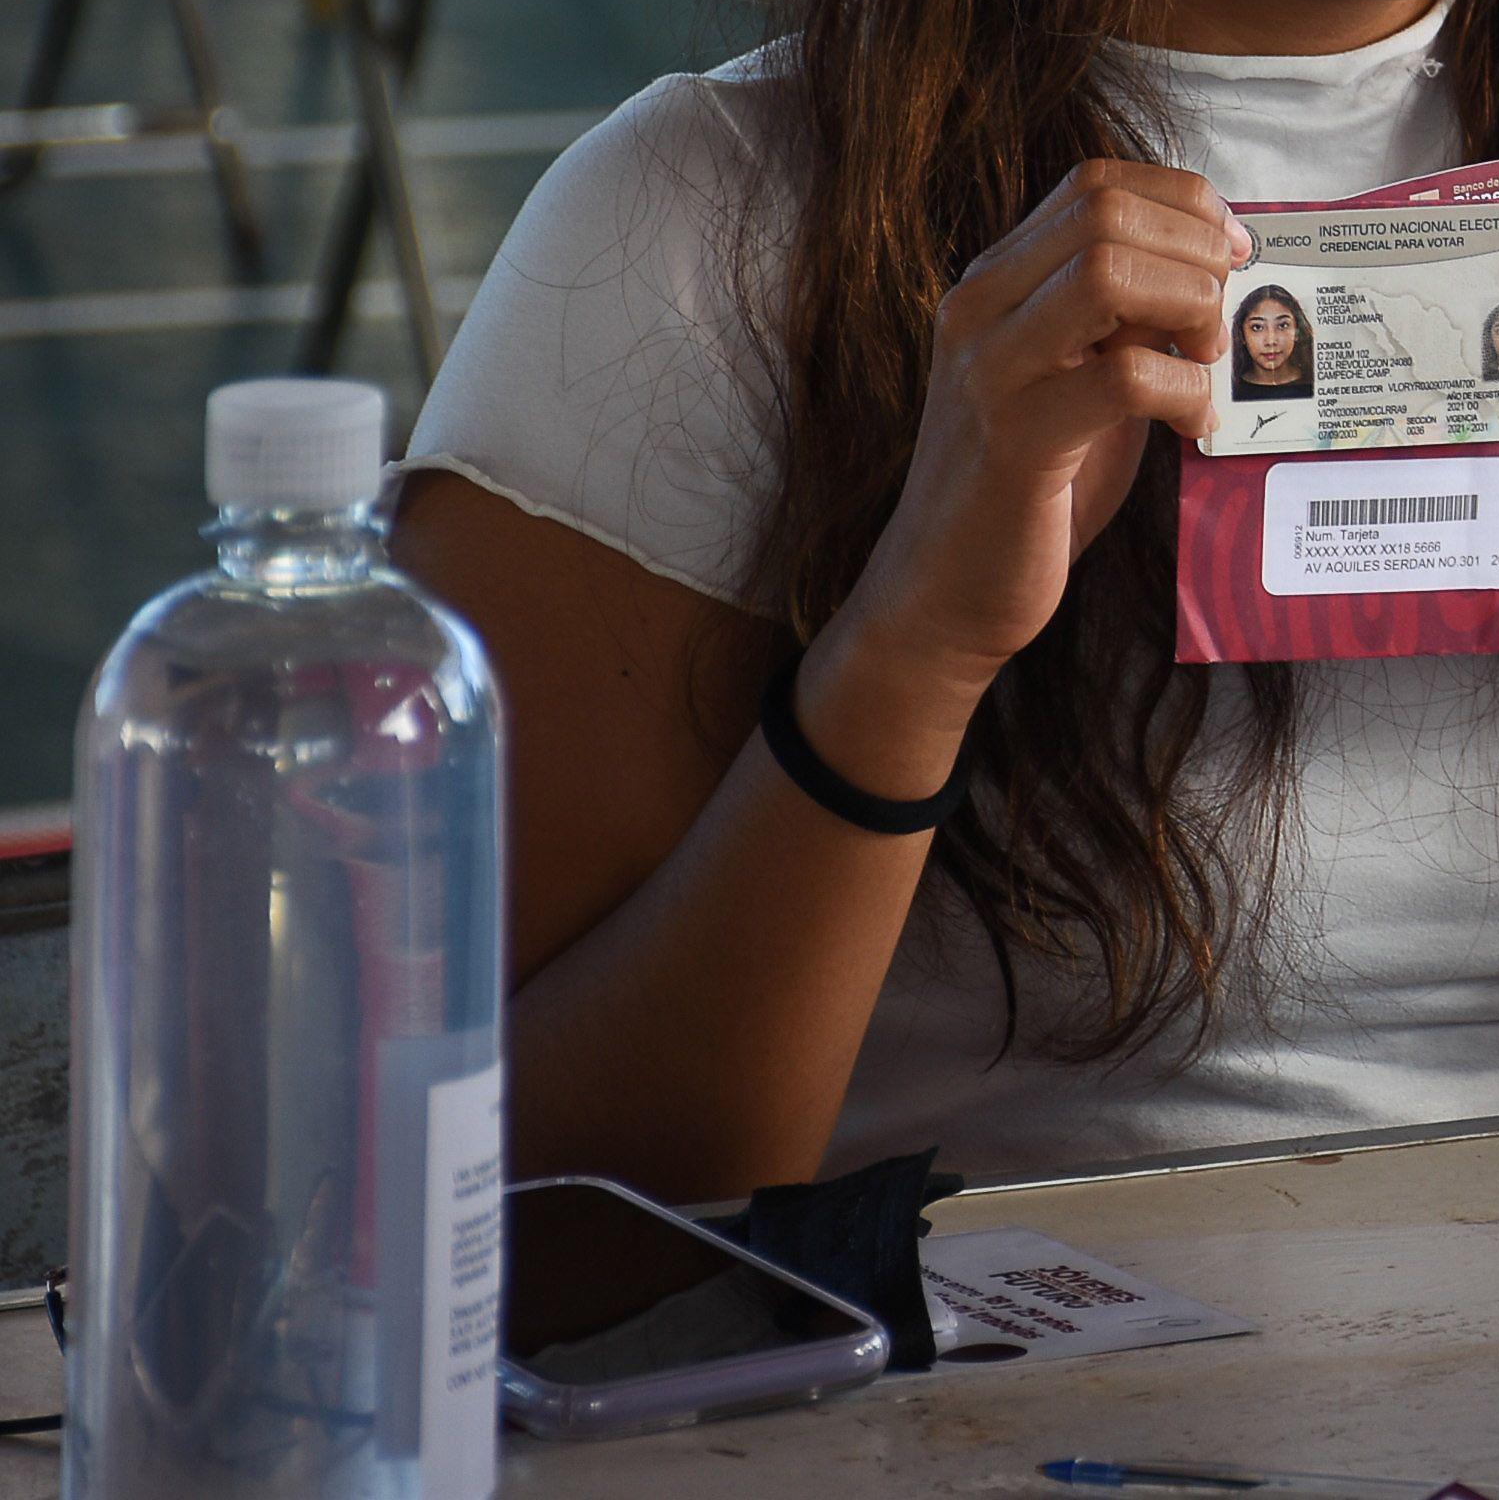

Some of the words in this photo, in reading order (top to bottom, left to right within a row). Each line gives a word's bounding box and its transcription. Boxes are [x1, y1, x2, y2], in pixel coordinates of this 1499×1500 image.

[1453, 182, 1485, 195] Banco
[1319, 222, 1386, 237] INSTITUTO
[1390, 220, 1455, 234] NACIONAL
[1266, 234, 1311, 247] MÉXICO
[1320, 239, 1391, 253] CREDENCIAL
[1395, 238, 1424, 250] PARA
[1427, 237, 1464, 248] VOTAR
[1316, 285, 1346, 294] NOMBRE
[1316, 295, 1366, 305] VILLANUEVA
[1316, 305, 1351, 315] ORTEGA
[1316, 315, 1345, 325] YARELI
[1347, 313, 1384, 323] ADAMARI
[1317, 341, 1352, 350] DOMICILIO
[1317, 351, 1325, 360] C
[1325, 351, 1334, 360] 23
[1336, 350, 1354, 360] NUM
[1356, 349, 1370, 359] 102
[1335, 359, 1389, 370] REVOLUCION
[1317, 369, 1366, 380] CAMPECHE,
[1366, 368, 1392, 378] CAMP.
[1318, 387, 1339, 396] CLAVE
[1341, 386, 1350, 395] DE
[1352, 385, 1383, 394] ELECTOR
[1447, 391, 1461, 400] AÑO
[1463, 391, 1472, 399] DE
[1318, 399, 1337, 407] CURP
[1447, 402, 1464, 412] 2021
[1319, 421, 1341, 429] FECHA
[1342, 420, 1352, 428] DE
[1353, 418, 1395, 427] NACIMIENTO
[1407, 416, 1436, 425] SECCIÓN
[1446, 414, 1477, 423] VIGENCIA
[1447, 424, 1465, 434] 2021
[1471, 423, 1488, 432] 2031
[1318, 429, 1358, 440] 07/09/2003
[1305, 531, 1335, 542] Num.
[1340, 529, 1380, 542] Tarjeta
[1305, 546, 1339, 557] XXXX
[1343, 545, 1376, 556] XXXX
[1380, 543, 1410, 555] XX18
[1413, 542, 1441, 553] 5666
[1305, 563, 1322, 574] AV
[1325, 560, 1380, 574] AQUILES
[1383, 558, 1435, 572] SERDAN
[1039, 1264, 1146, 1304] JÓVENES
